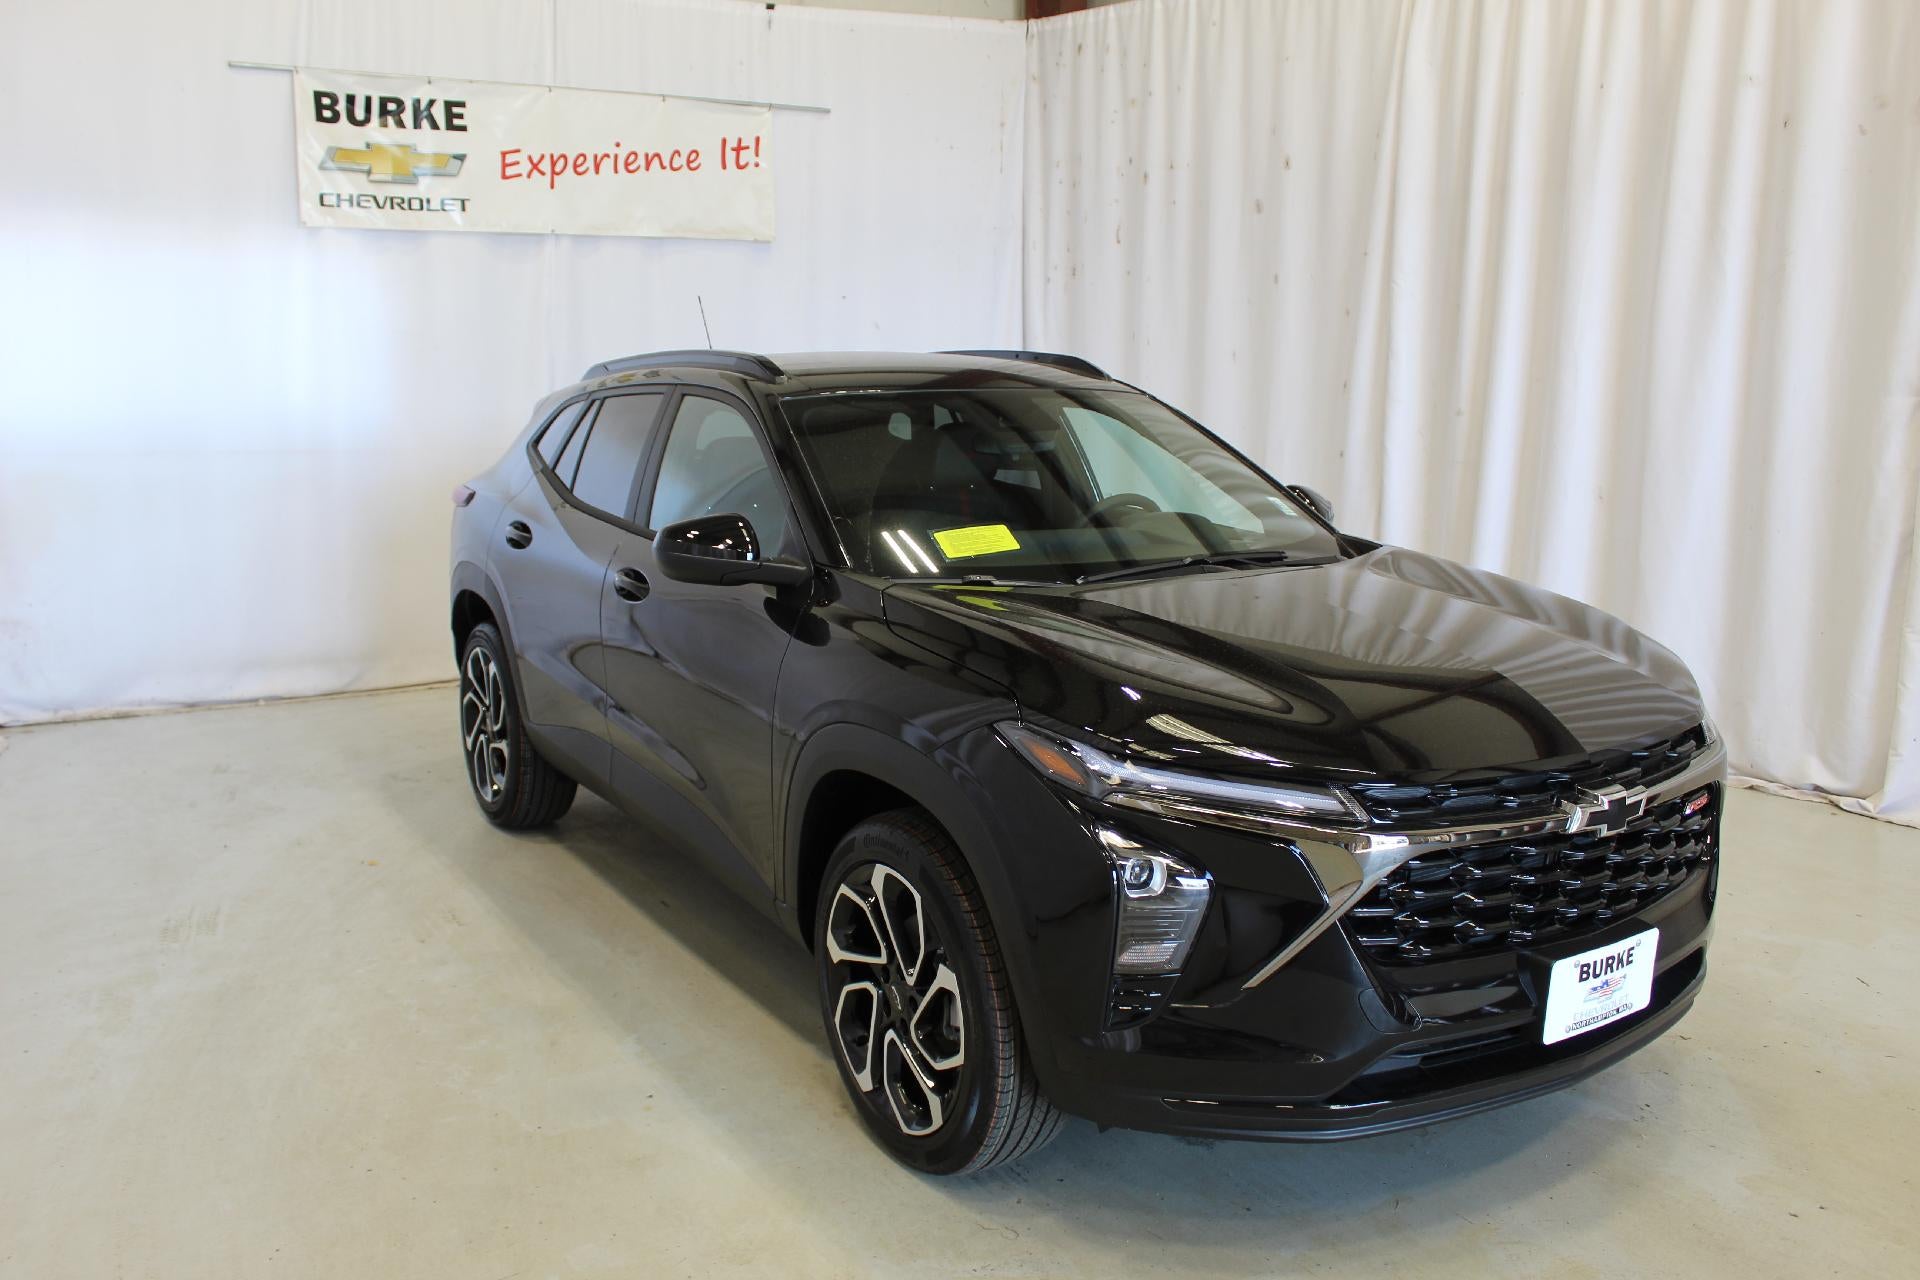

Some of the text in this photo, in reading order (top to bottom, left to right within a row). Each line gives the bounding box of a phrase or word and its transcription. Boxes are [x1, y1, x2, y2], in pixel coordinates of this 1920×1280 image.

[313, 90, 468, 132] BURKE
[500, 135, 761, 189] Experience It!
[318, 192, 471, 212] CHEVROLET
[1578, 946, 1635, 983] BURKE
